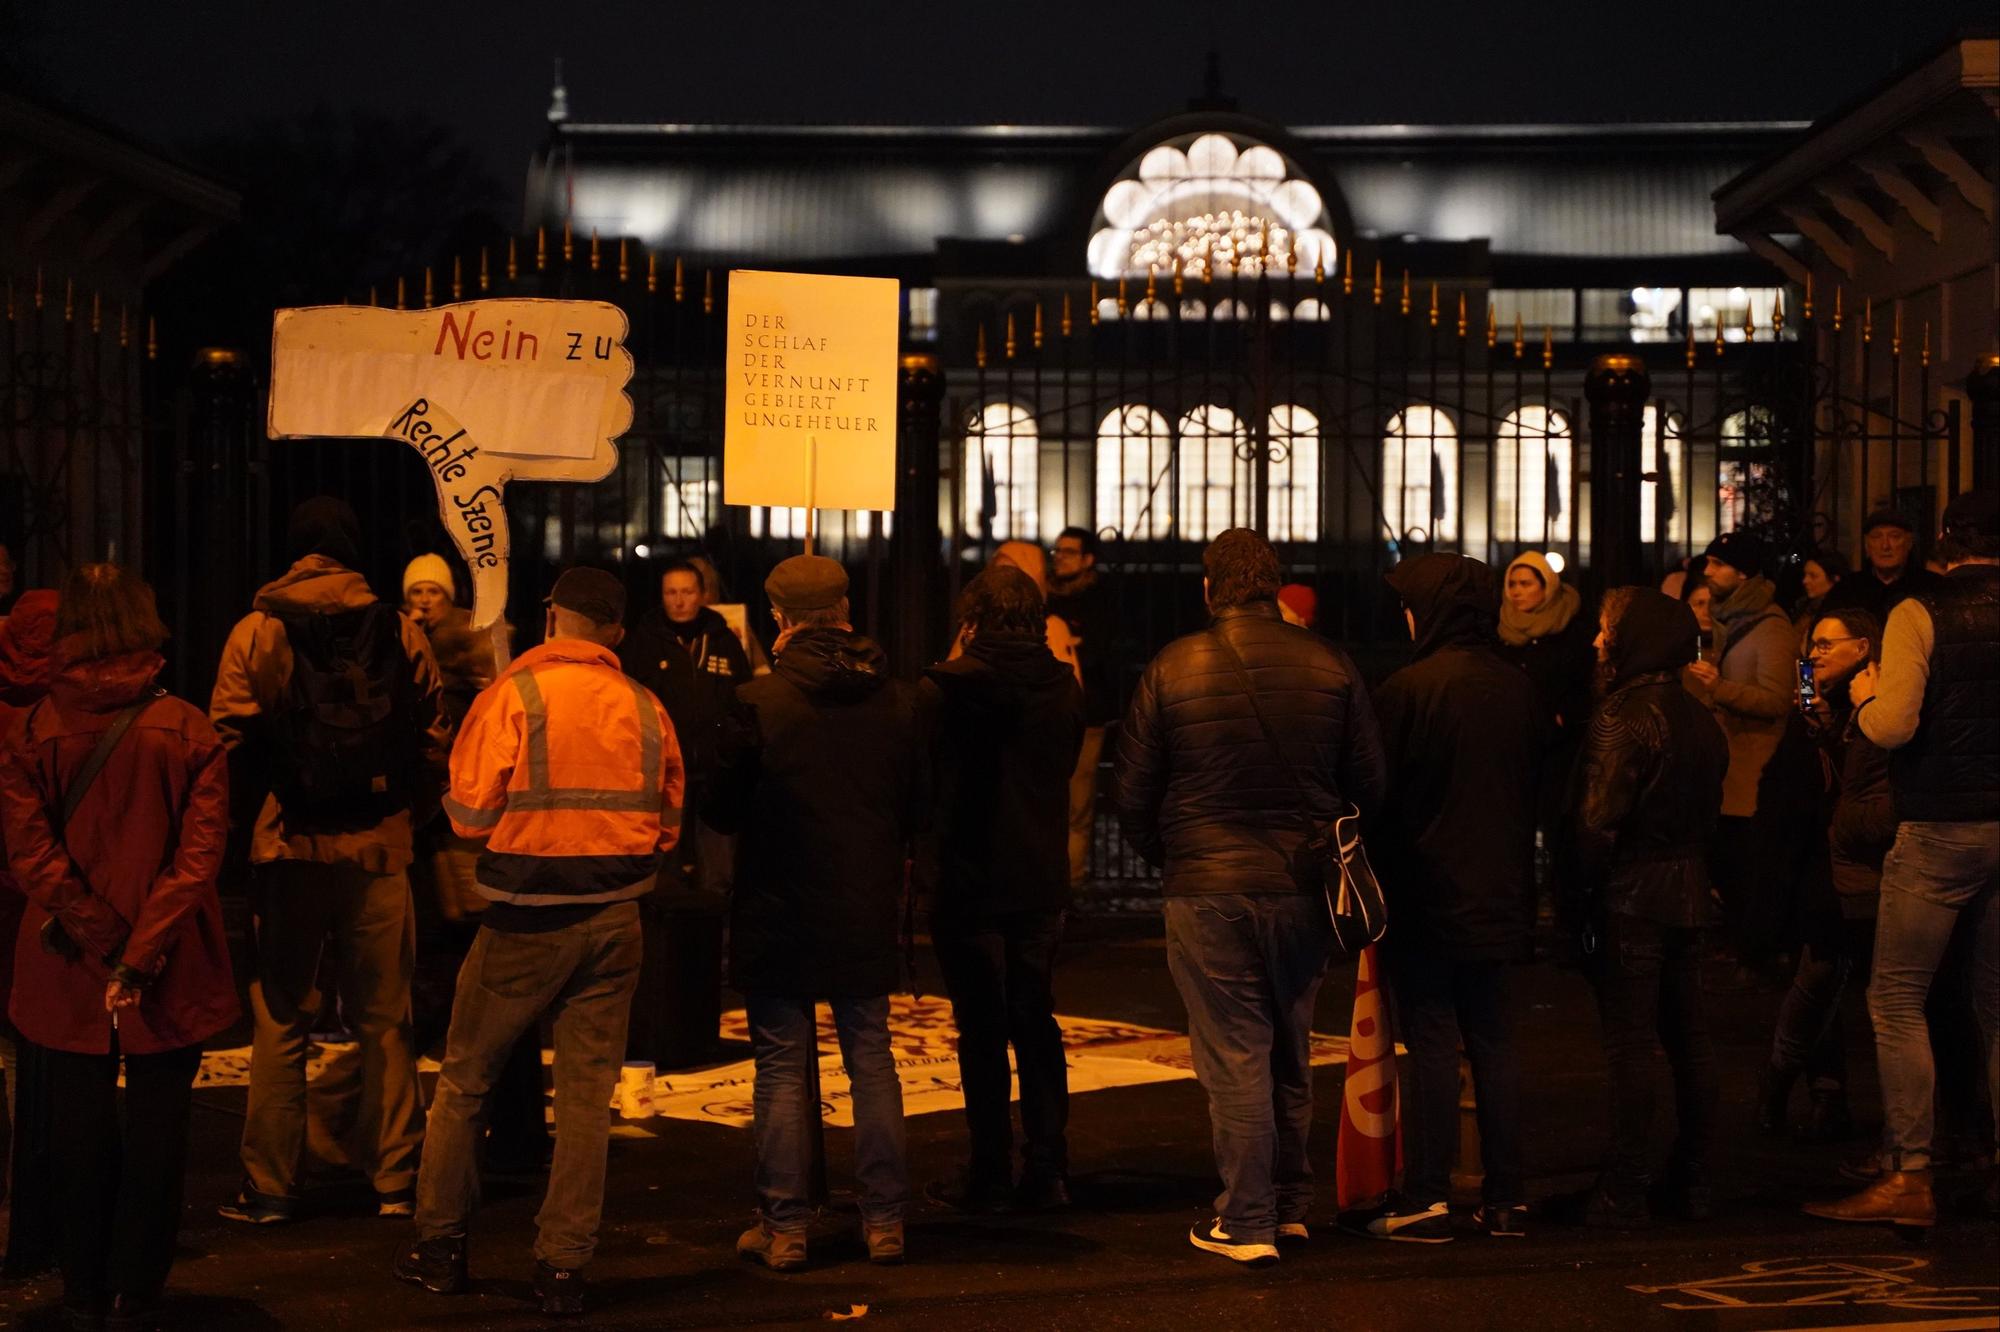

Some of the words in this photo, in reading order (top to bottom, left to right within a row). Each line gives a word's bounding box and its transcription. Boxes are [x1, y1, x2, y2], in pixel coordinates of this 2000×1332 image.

[745, 313, 785, 330] DER
[434, 310, 538, 361] Nein
[565, 331, 612, 360] zu
[744, 333, 828, 352] SCHLAF
[744, 353, 785, 369] DER
[744, 373, 869, 392] VERNUNFT
[744, 393, 836, 410] GEBIERT
[744, 412, 878, 431] UNGEHEUER
[392, 398, 479, 483] Rechte
[453, 485, 501, 568] Szene
